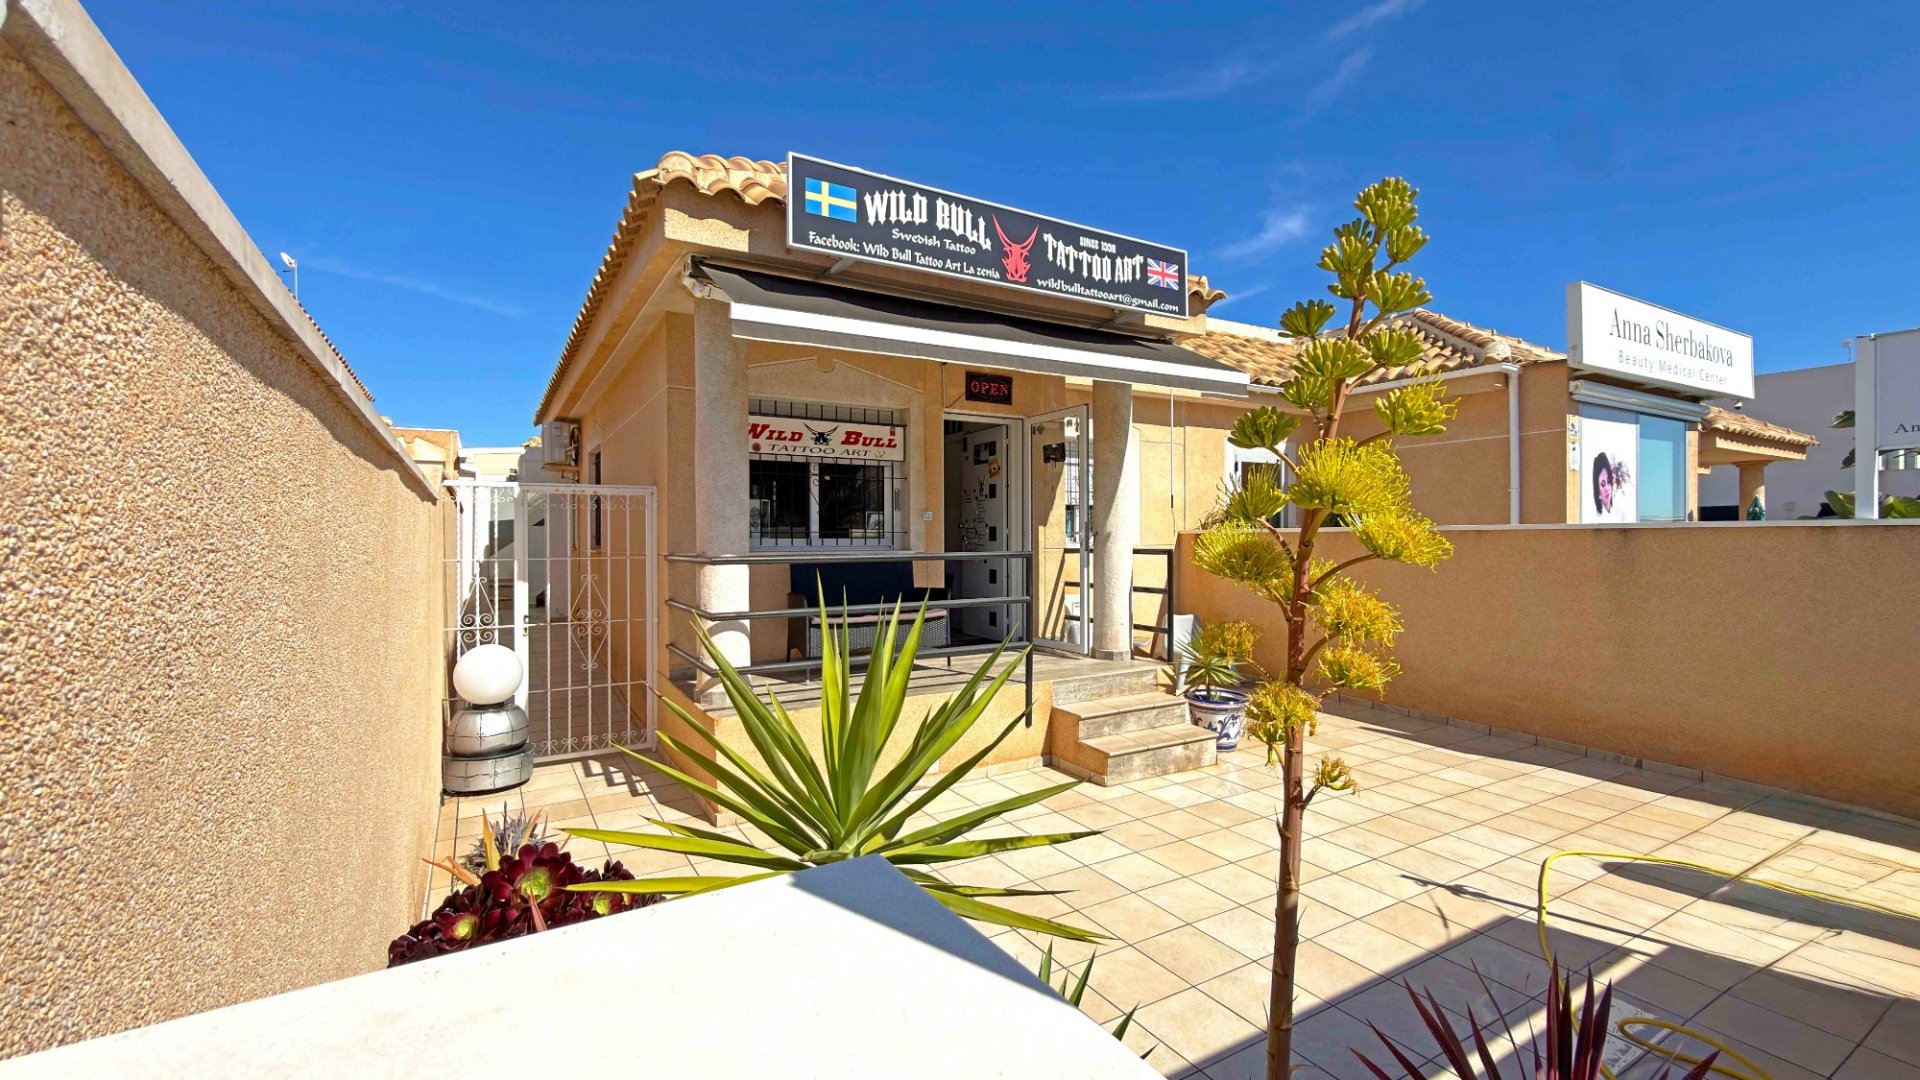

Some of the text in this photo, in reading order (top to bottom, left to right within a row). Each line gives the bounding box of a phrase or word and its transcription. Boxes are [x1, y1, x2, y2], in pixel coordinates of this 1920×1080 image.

[863, 189, 992, 251] WILD BULL
[808, 231, 1000, 279] Facebook: Wild Bull Tattoo Art La zenia
[892, 228, 976, 255] Swedish Tattoo
[1043, 232, 1144, 284] TATTOO ART
[1080, 235, 1099, 250] SINCE
[1036, 278, 1179, 313] wildbulltattooart@gmail.com
[1609, 307, 1733, 367] Anna Sherbakova
[1618, 350, 1727, 385] Beauty Medical Center
[970, 379, 1008, 396] OPEN
[748, 423, 898, 449] WILD BULL
[769, 443, 872, 457] TATTOO ART
